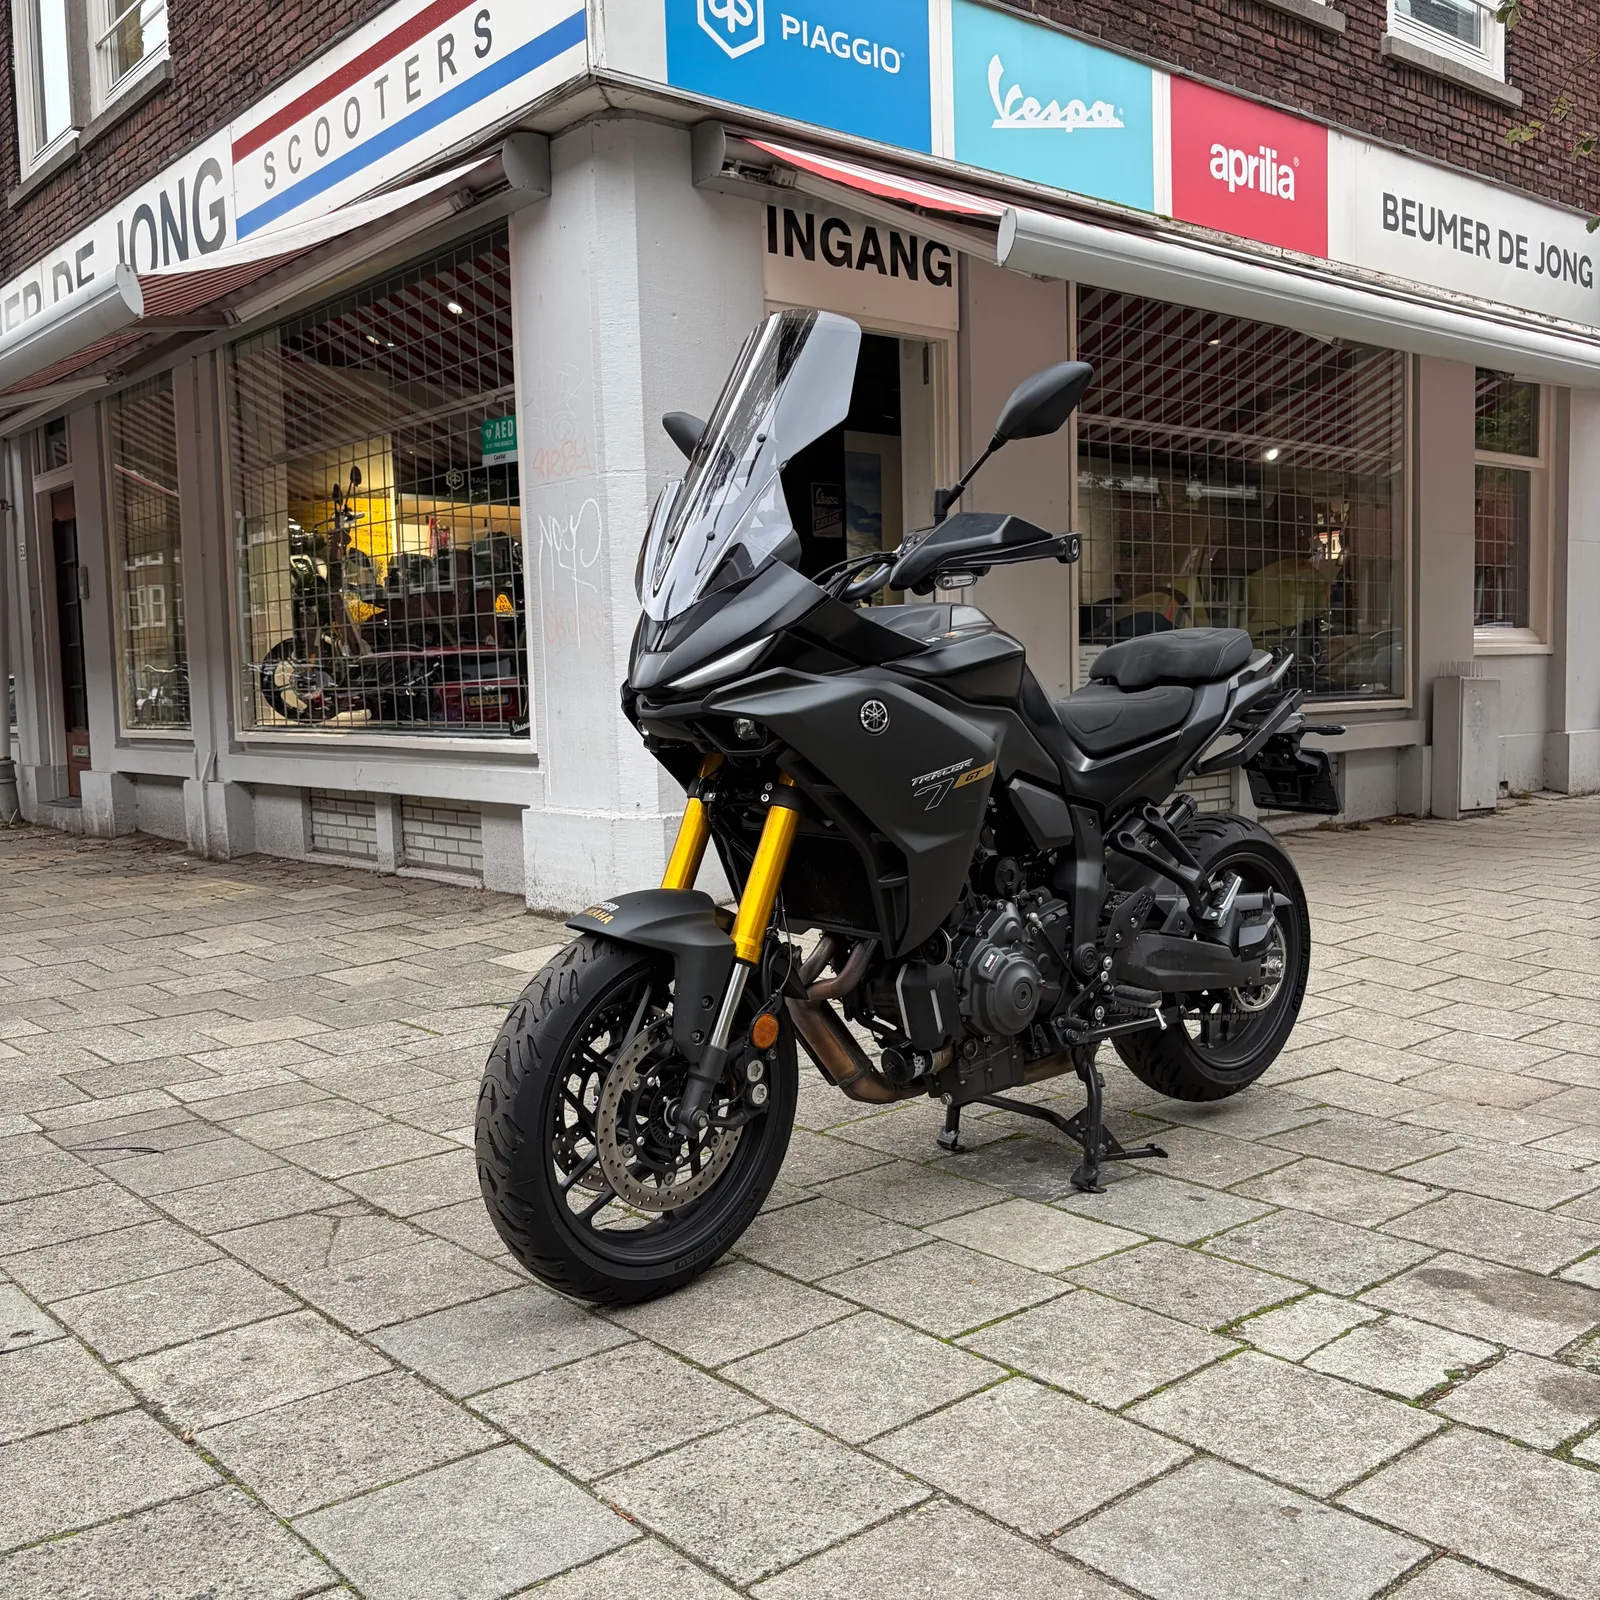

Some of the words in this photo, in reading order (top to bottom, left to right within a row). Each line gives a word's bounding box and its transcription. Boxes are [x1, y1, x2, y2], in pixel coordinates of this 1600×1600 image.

[780, 13, 901, 74] PIAGGIO
[264, 9, 494, 190] SCOOTERS
[988, 53, 1125, 132] Vespa
[1210, 143, 1295, 202] aprilia
[116, 157, 227, 274] JONG
[766, 204, 953, 288] INGANG
[1382, 191, 1491, 260] BEUMER
[1498, 228, 1529, 271] DE
[1534, 241, 1594, 290] JONG
[495, 419, 514, 440] AED
[911, 757, 974, 787] TRACER
[913, 777, 955, 812] 7
[964, 768, 985, 783] GT
